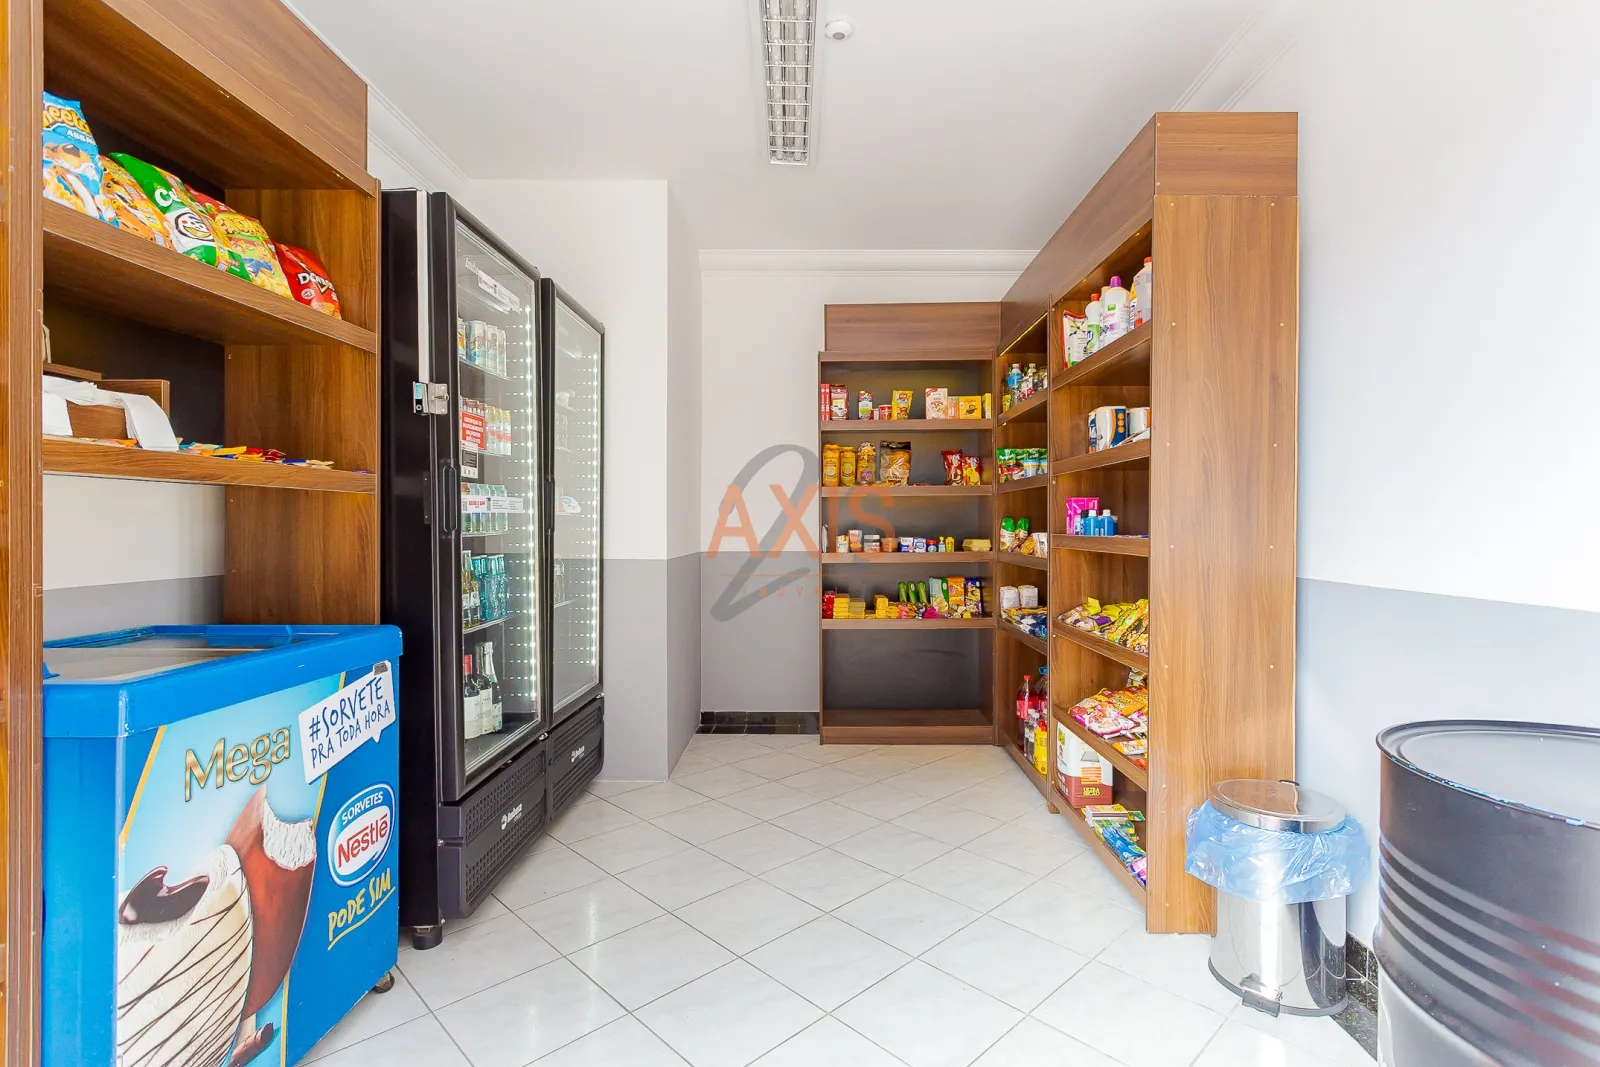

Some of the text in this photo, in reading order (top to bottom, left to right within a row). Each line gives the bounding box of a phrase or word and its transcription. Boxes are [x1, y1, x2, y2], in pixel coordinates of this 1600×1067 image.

[309, 677, 383, 743] #SORVETE
[311, 699, 391, 769] PRA TODA HORA
[184, 727, 291, 803] Mega
[337, 813, 388, 868] Nestlé
[341, 791, 383, 826] SORVETES
[328, 867, 391, 941] PODE SIM
